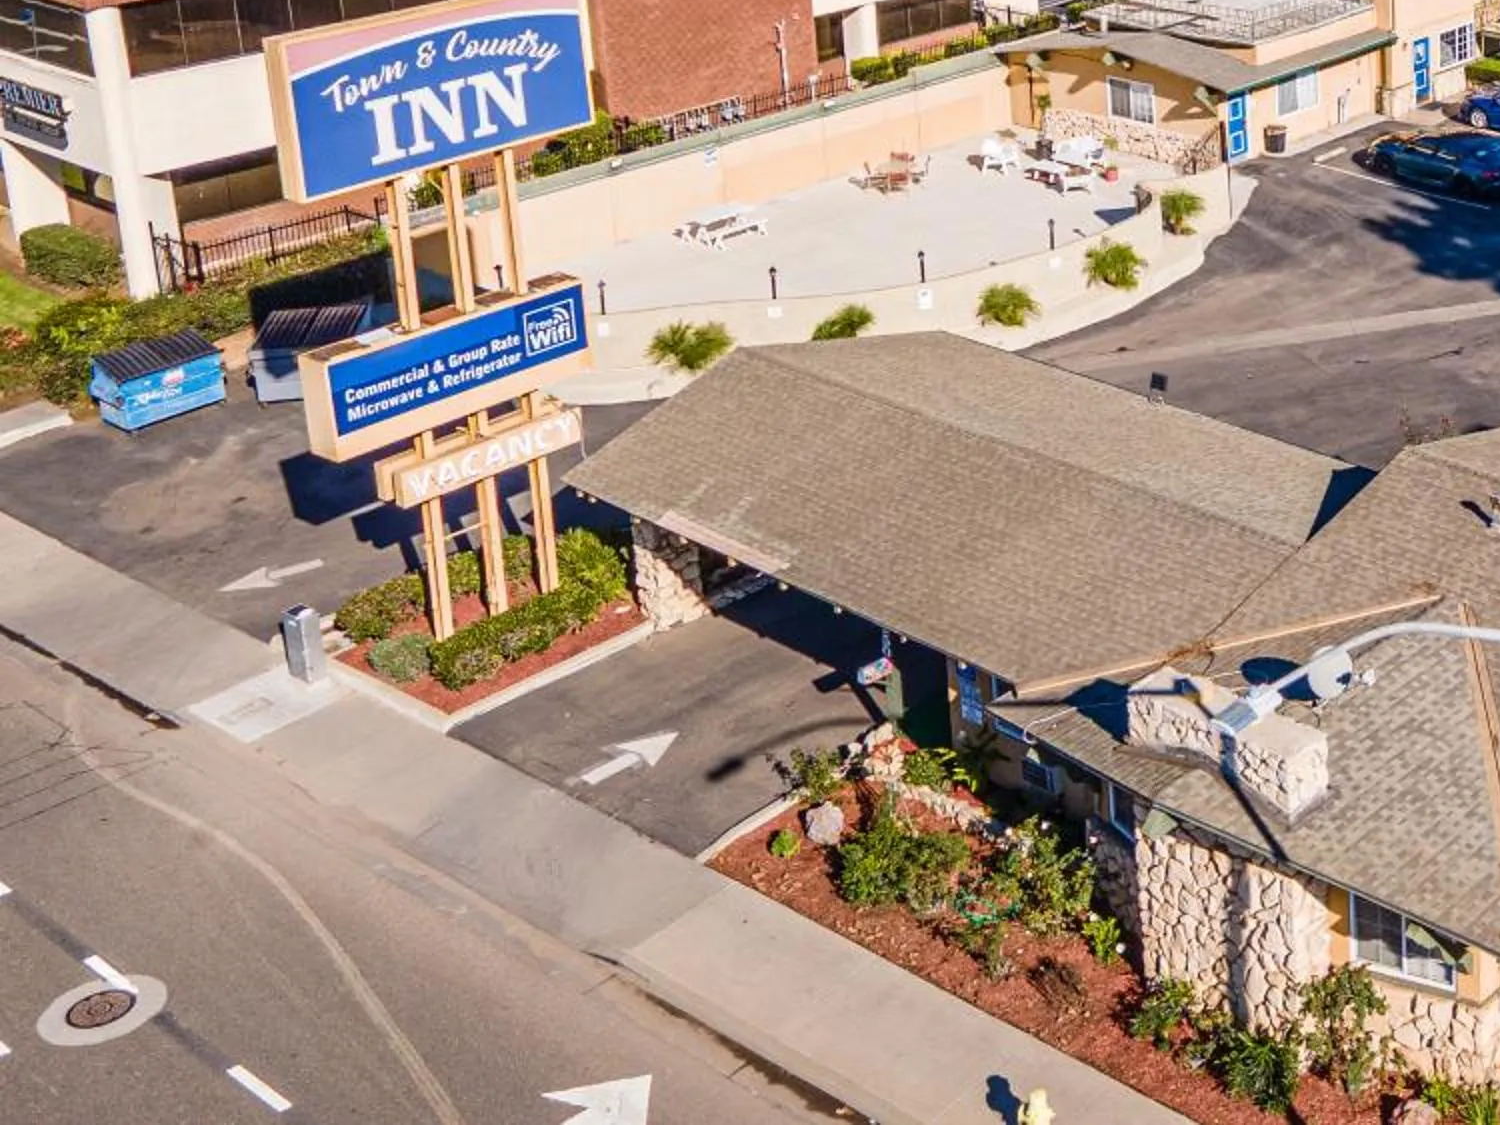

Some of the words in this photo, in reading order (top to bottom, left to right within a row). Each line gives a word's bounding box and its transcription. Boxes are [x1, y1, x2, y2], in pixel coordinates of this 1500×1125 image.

[0, 80, 61, 115] REMIER
[320, 59, 408, 112] Town
[416, 40, 436, 68] &
[446, 29, 561, 72] Country
[364, 63, 529, 166] INN
[344, 364, 429, 404] Commercial
[433, 360, 446, 375] &
[449, 347, 488, 369] Group
[491, 334, 521, 354] Rate
[529, 323, 571, 350] Wifi
[347, 387, 424, 423] Microwave
[427, 380, 440, 395] &
[443, 352, 523, 390] Refrigerator
[406, 415, 574, 499] VACANCY
